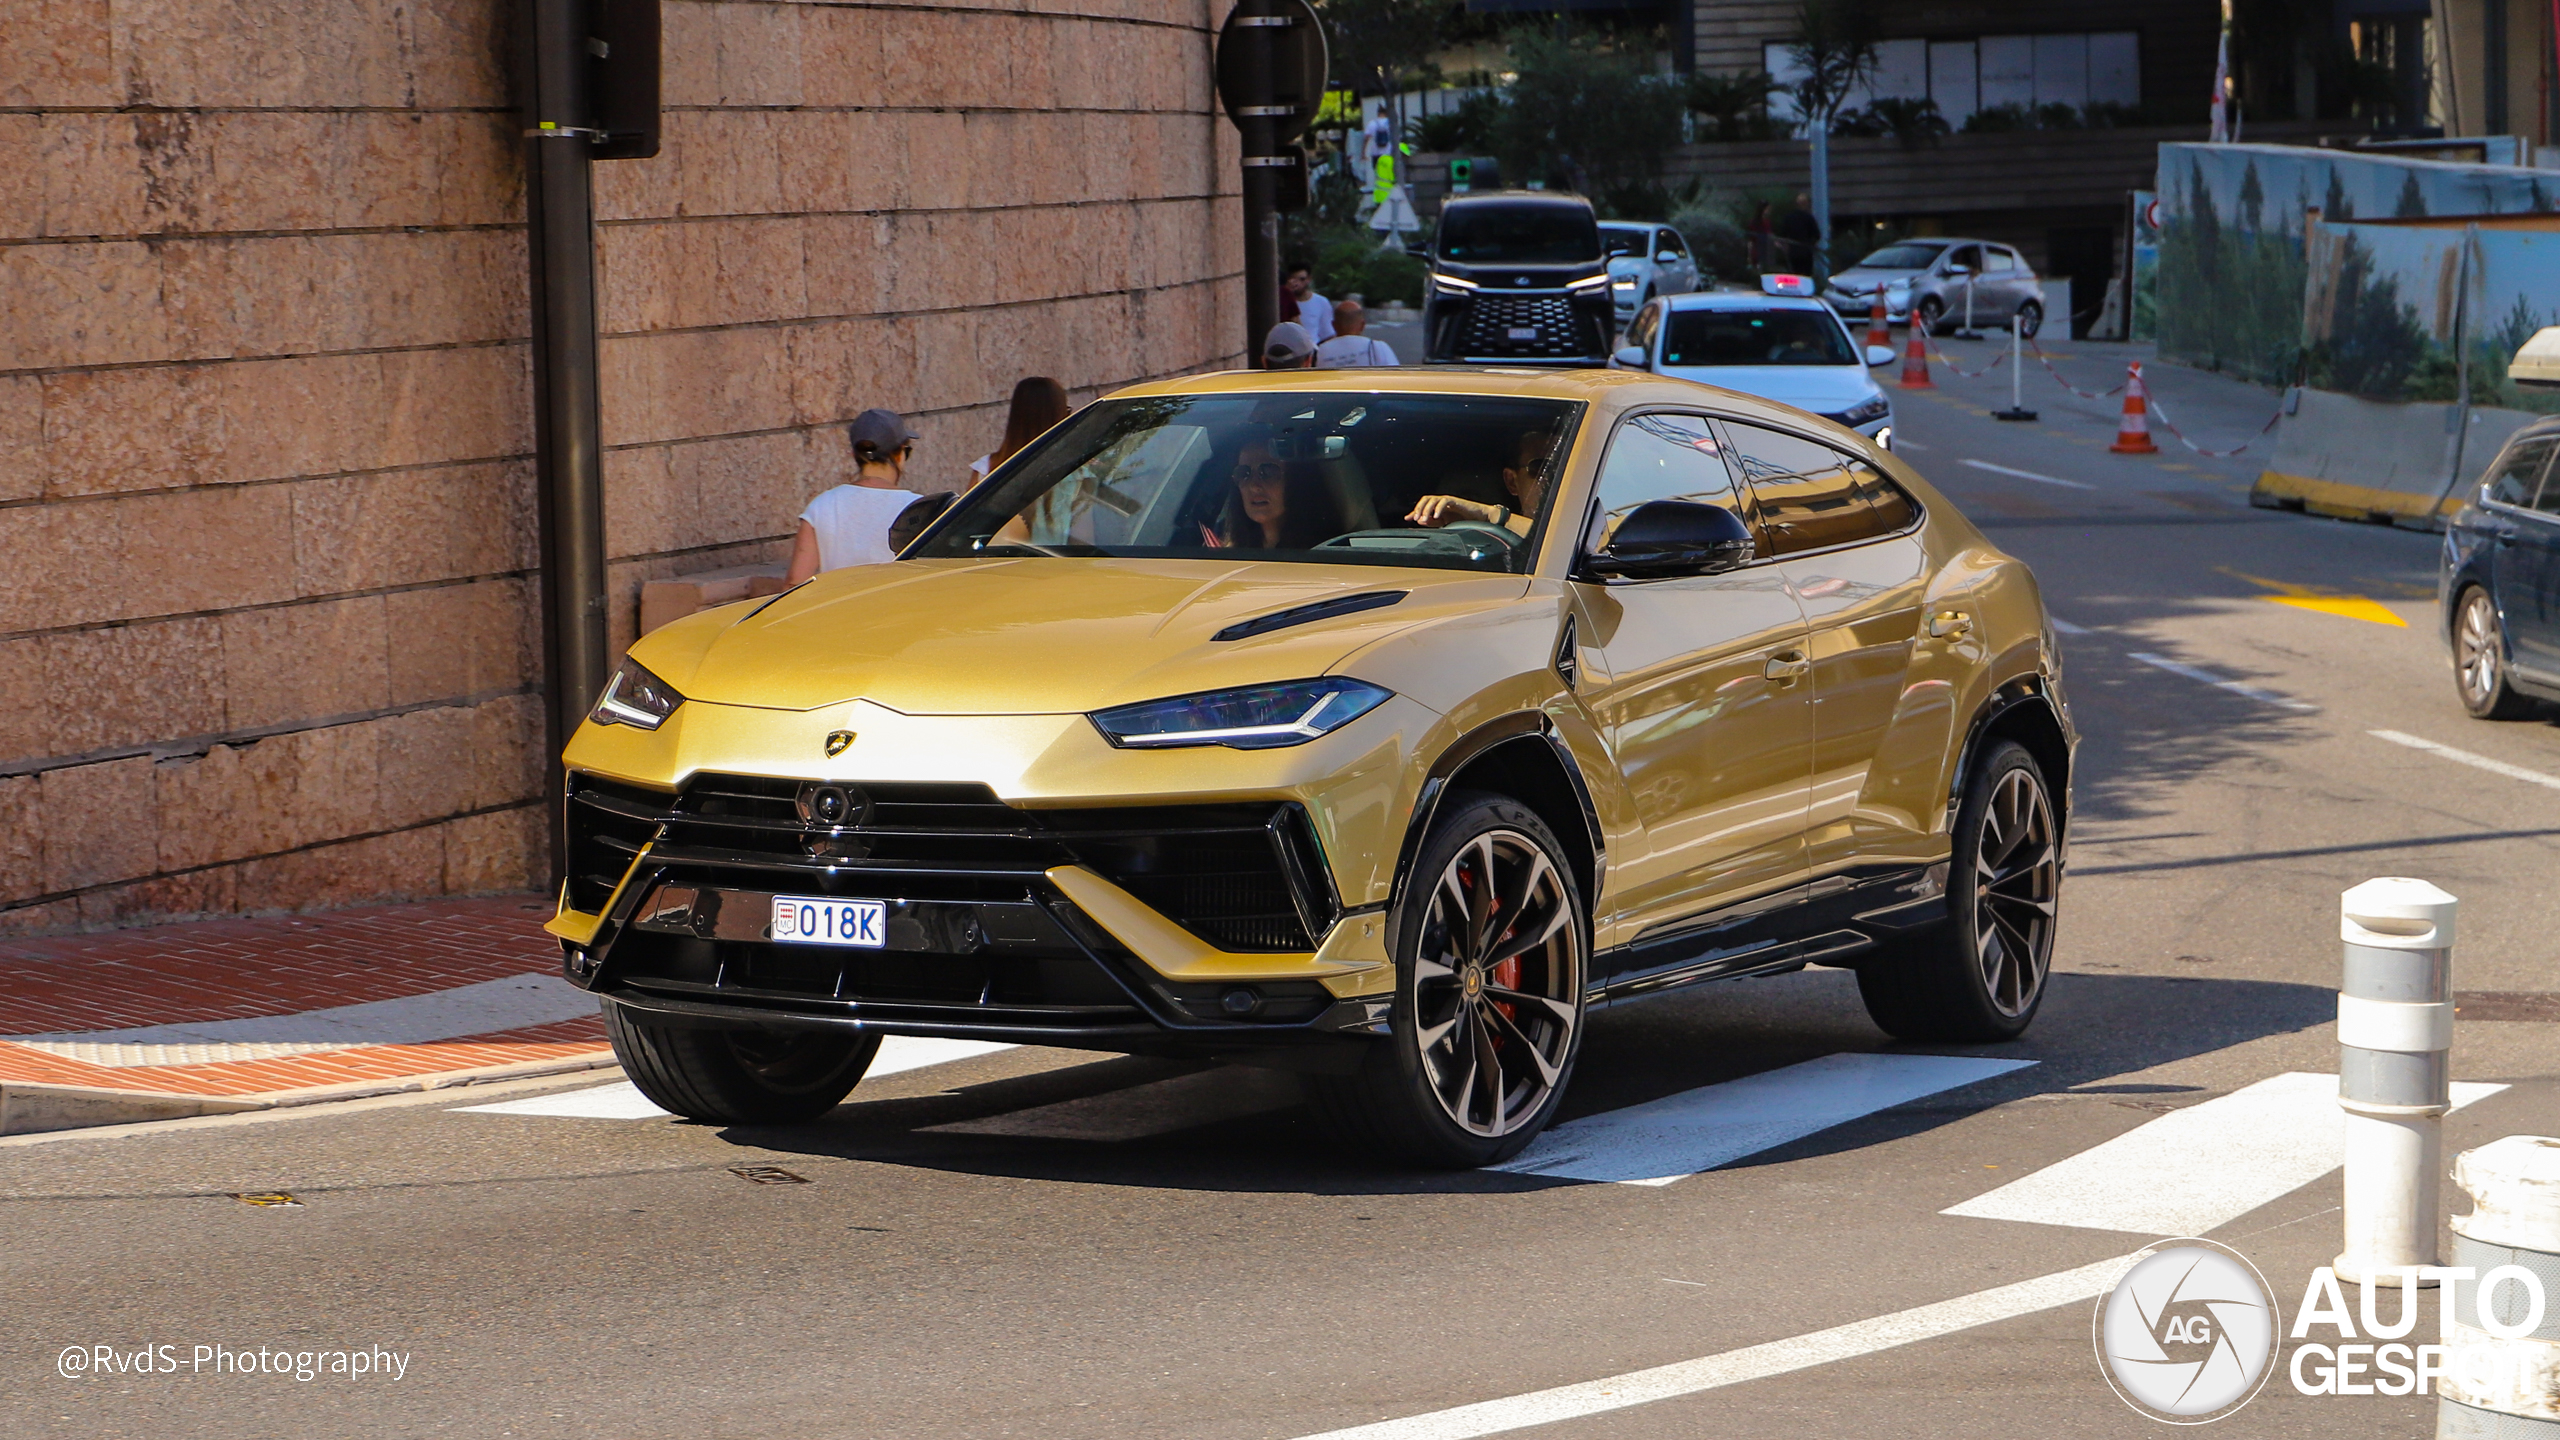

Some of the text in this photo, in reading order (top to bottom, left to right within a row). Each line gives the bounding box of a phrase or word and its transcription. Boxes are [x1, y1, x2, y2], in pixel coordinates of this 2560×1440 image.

[1514, 811, 1524, 820] P
[780, 904, 878, 940] MC 018K
